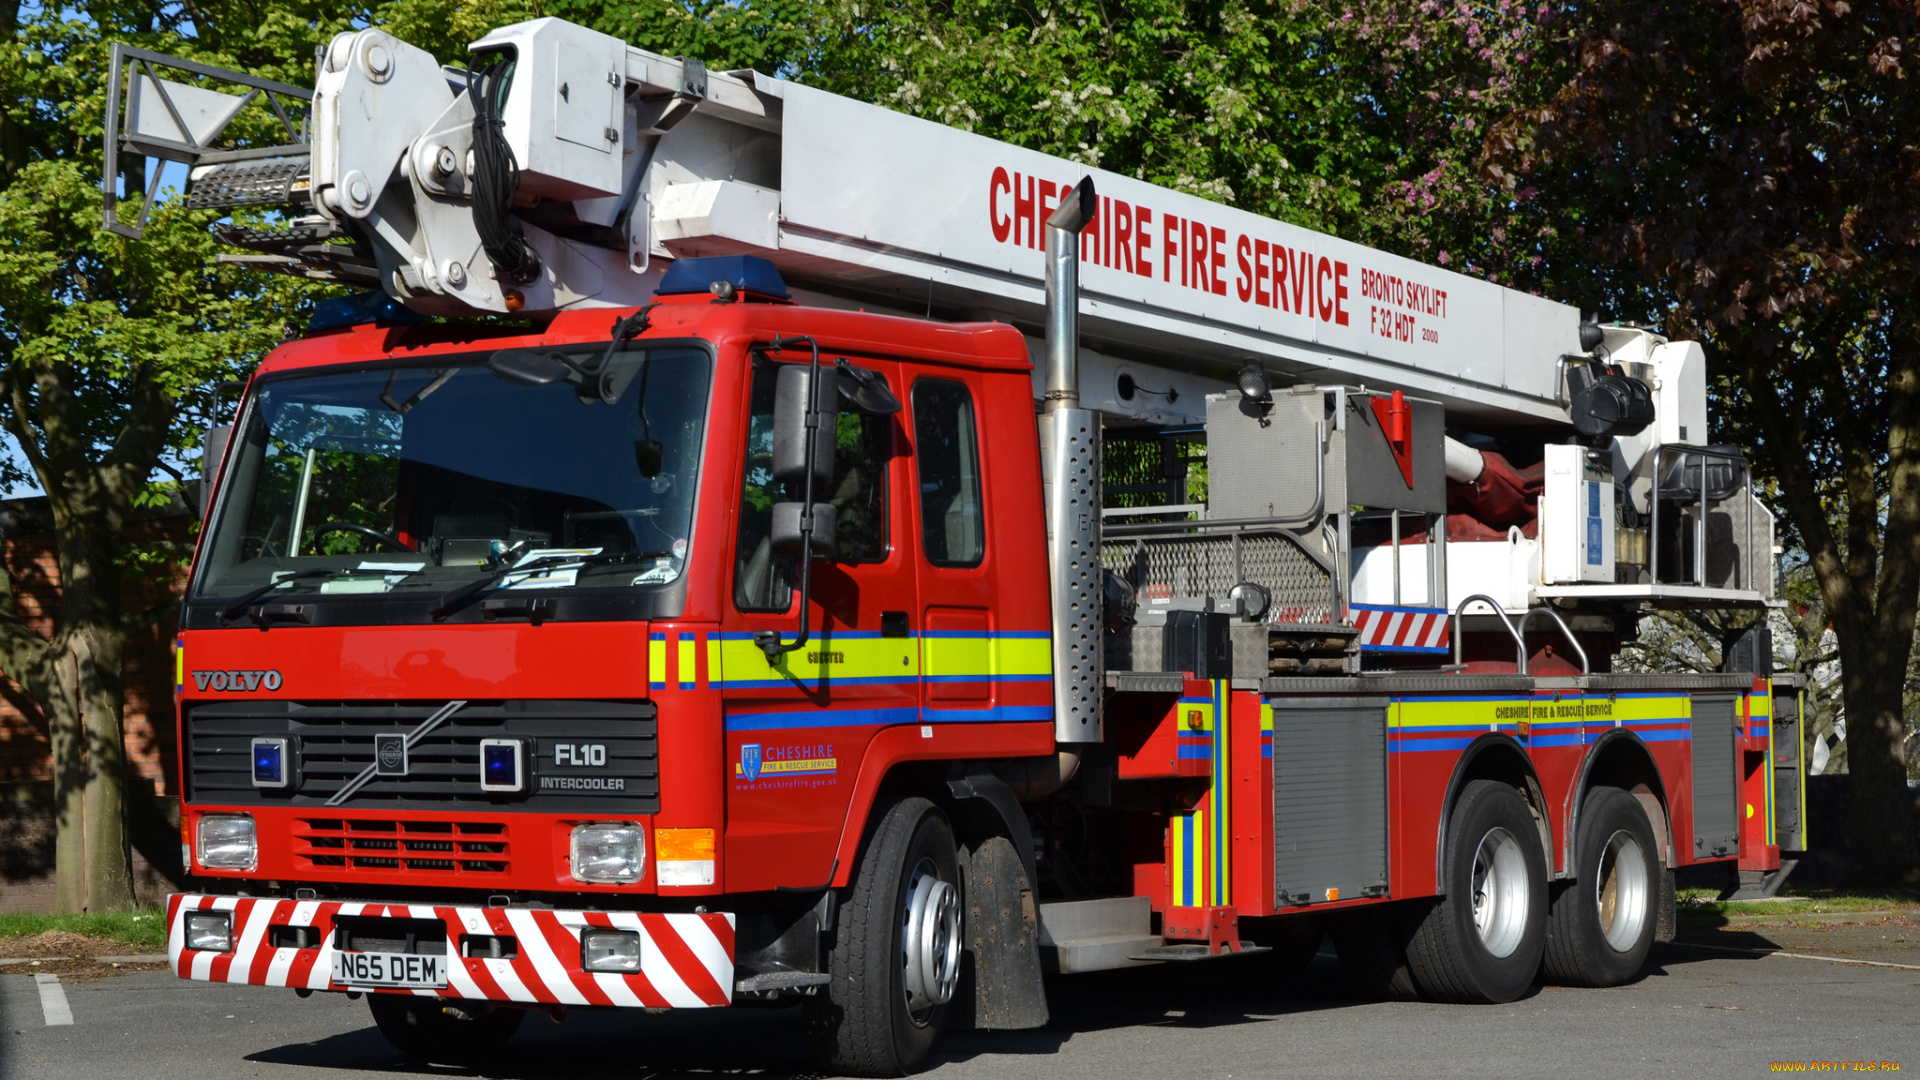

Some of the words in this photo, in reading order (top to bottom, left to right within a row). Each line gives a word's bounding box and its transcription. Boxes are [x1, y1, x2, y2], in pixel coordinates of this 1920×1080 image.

[990, 166, 1152, 279] CHEHIRE
[1163, 213, 1227, 297] FIRE
[1236, 233, 1350, 327] SERVICE
[1361, 267, 1404, 307] BRONTO
[1406, 280, 1447, 319] SKYLIFT
[1371, 305, 1377, 334] F
[1380, 307, 1392, 339] 32
[1395, 311, 1415, 344] HDT
[1422, 327, 1439, 344] 2000
[807, 651, 844, 664] CHESTER
[191, 669, 283, 692] VOLVO
[1495, 705, 1529, 719] CHESHIRE
[1532, 706, 1548, 719] FIRE
[1550, 706, 1555, 718] &
[1557, 704, 1581, 718] RESCUE
[1585, 703, 1612, 716] SERVICE
[555, 743, 606, 766] FL10
[766, 744, 833, 760] CHESHIRE
[763, 763, 777, 771] FIRE
[779, 762, 784, 770] &
[785, 761, 808, 770] RESCUE
[810, 760, 834, 769] SERVICE
[541, 777, 624, 790] INTERCOOLER
[736, 778, 837, 791] www.cheshirefire.gov.uk
[341, 953, 383, 980] N65
[390, 956, 436, 982] DEM
